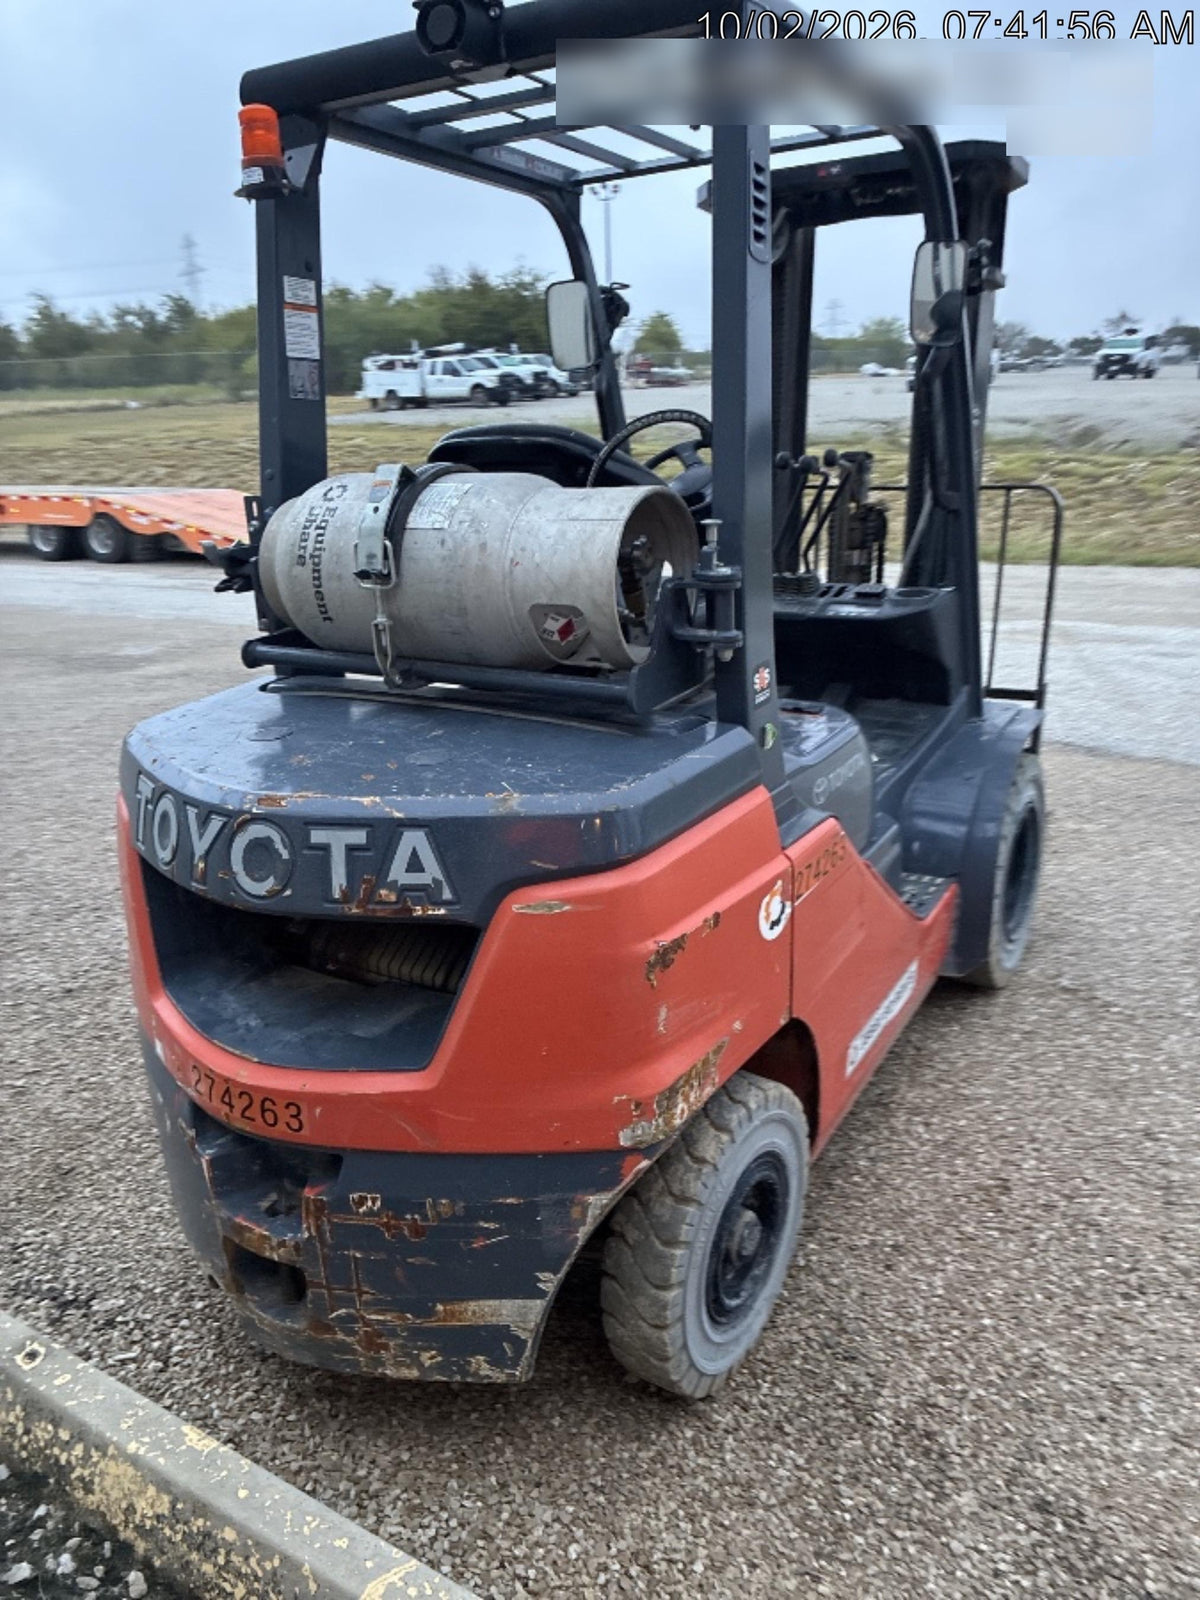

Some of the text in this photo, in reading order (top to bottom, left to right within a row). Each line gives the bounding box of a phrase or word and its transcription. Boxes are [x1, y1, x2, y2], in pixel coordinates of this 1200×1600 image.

[309, 506, 337, 624] Equipment
[135, 770, 454, 909] TOYOTA
[191, 1064, 305, 1134] 274263
